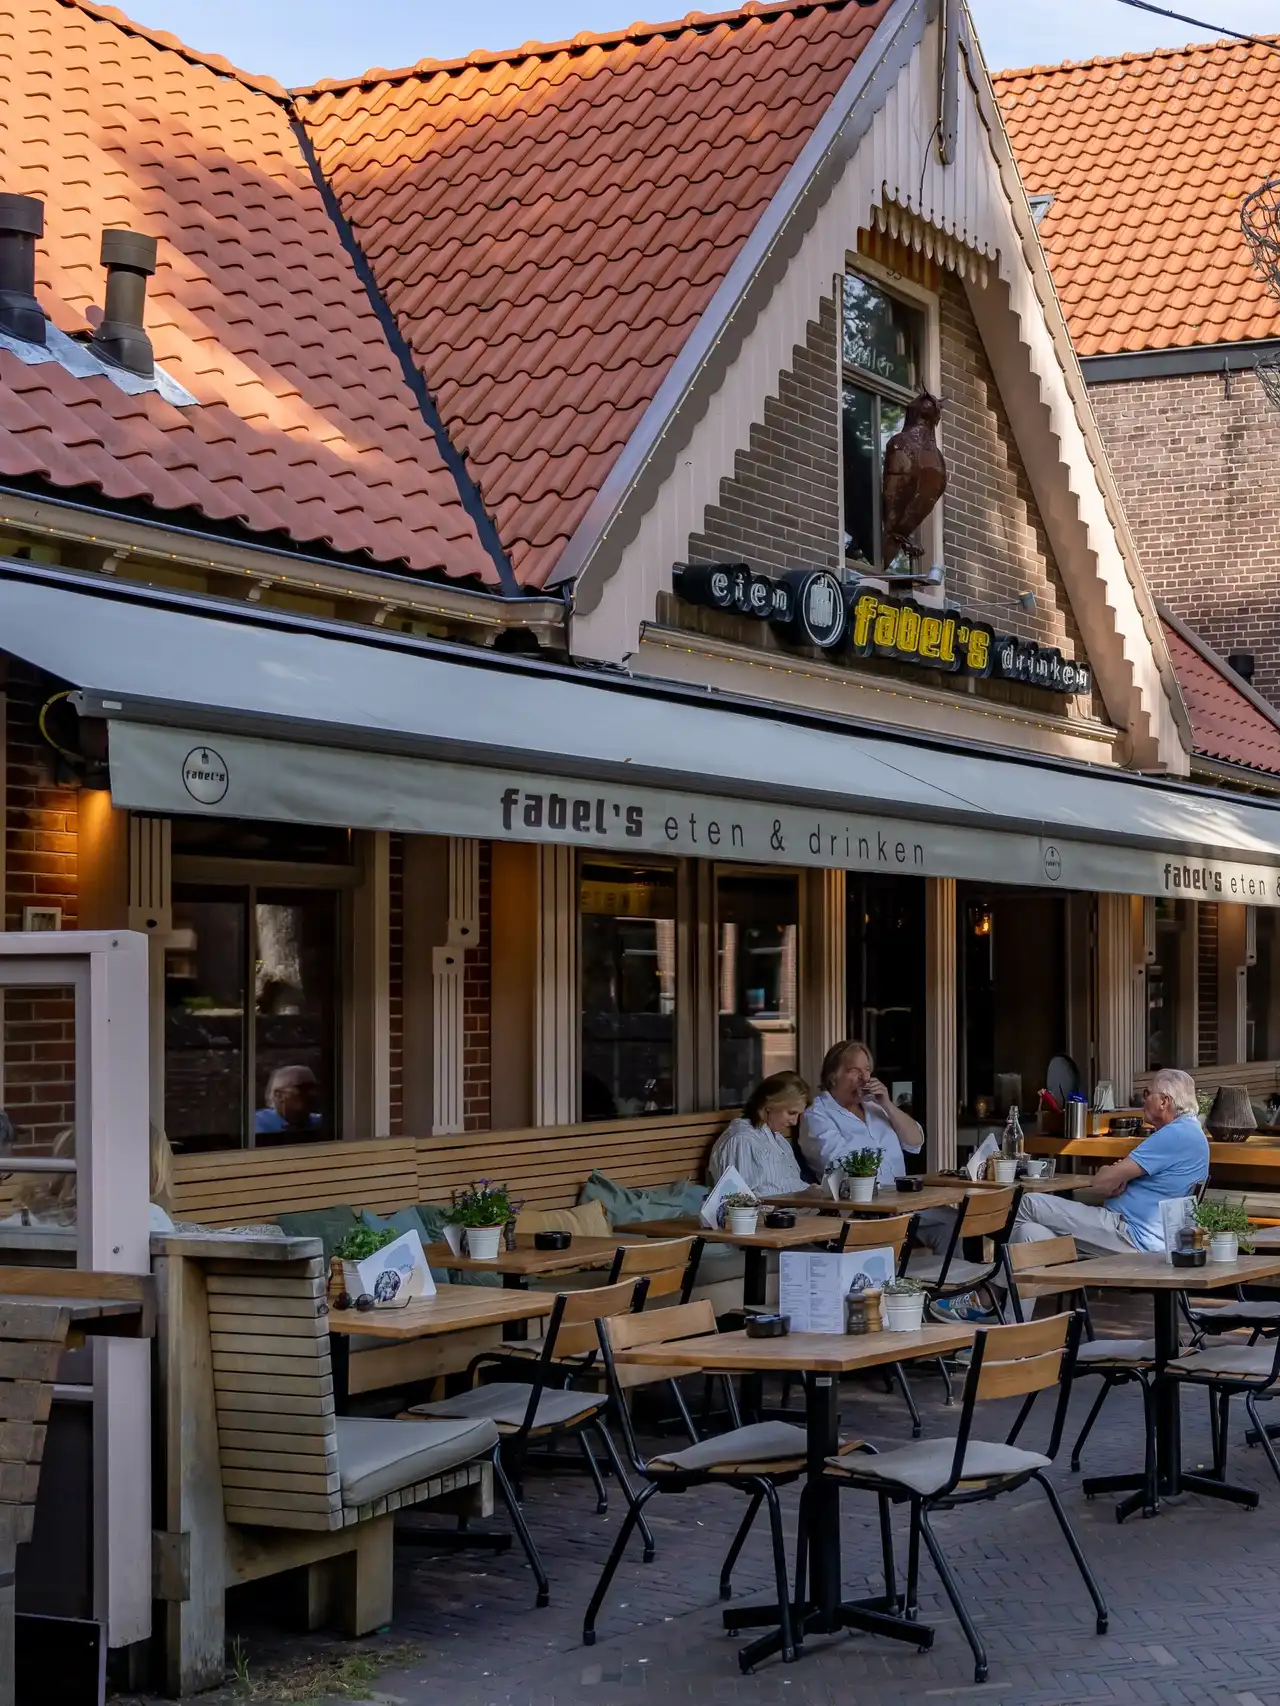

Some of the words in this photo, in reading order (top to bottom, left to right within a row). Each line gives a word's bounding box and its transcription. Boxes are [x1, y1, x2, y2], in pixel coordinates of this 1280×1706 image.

[711, 571, 788, 614] eten
[853, 594, 992, 671] fabel's
[1001, 643, 1088, 689] drinken
[186, 769, 225, 782] fabel's
[500, 787, 644, 838] fabel's
[664, 814, 745, 848] eten
[769, 818, 786, 852] &
[808, 823, 925, 867] drinken
[1163, 862, 1223, 893] fabel's
[1230, 873, 1266, 898] eten
